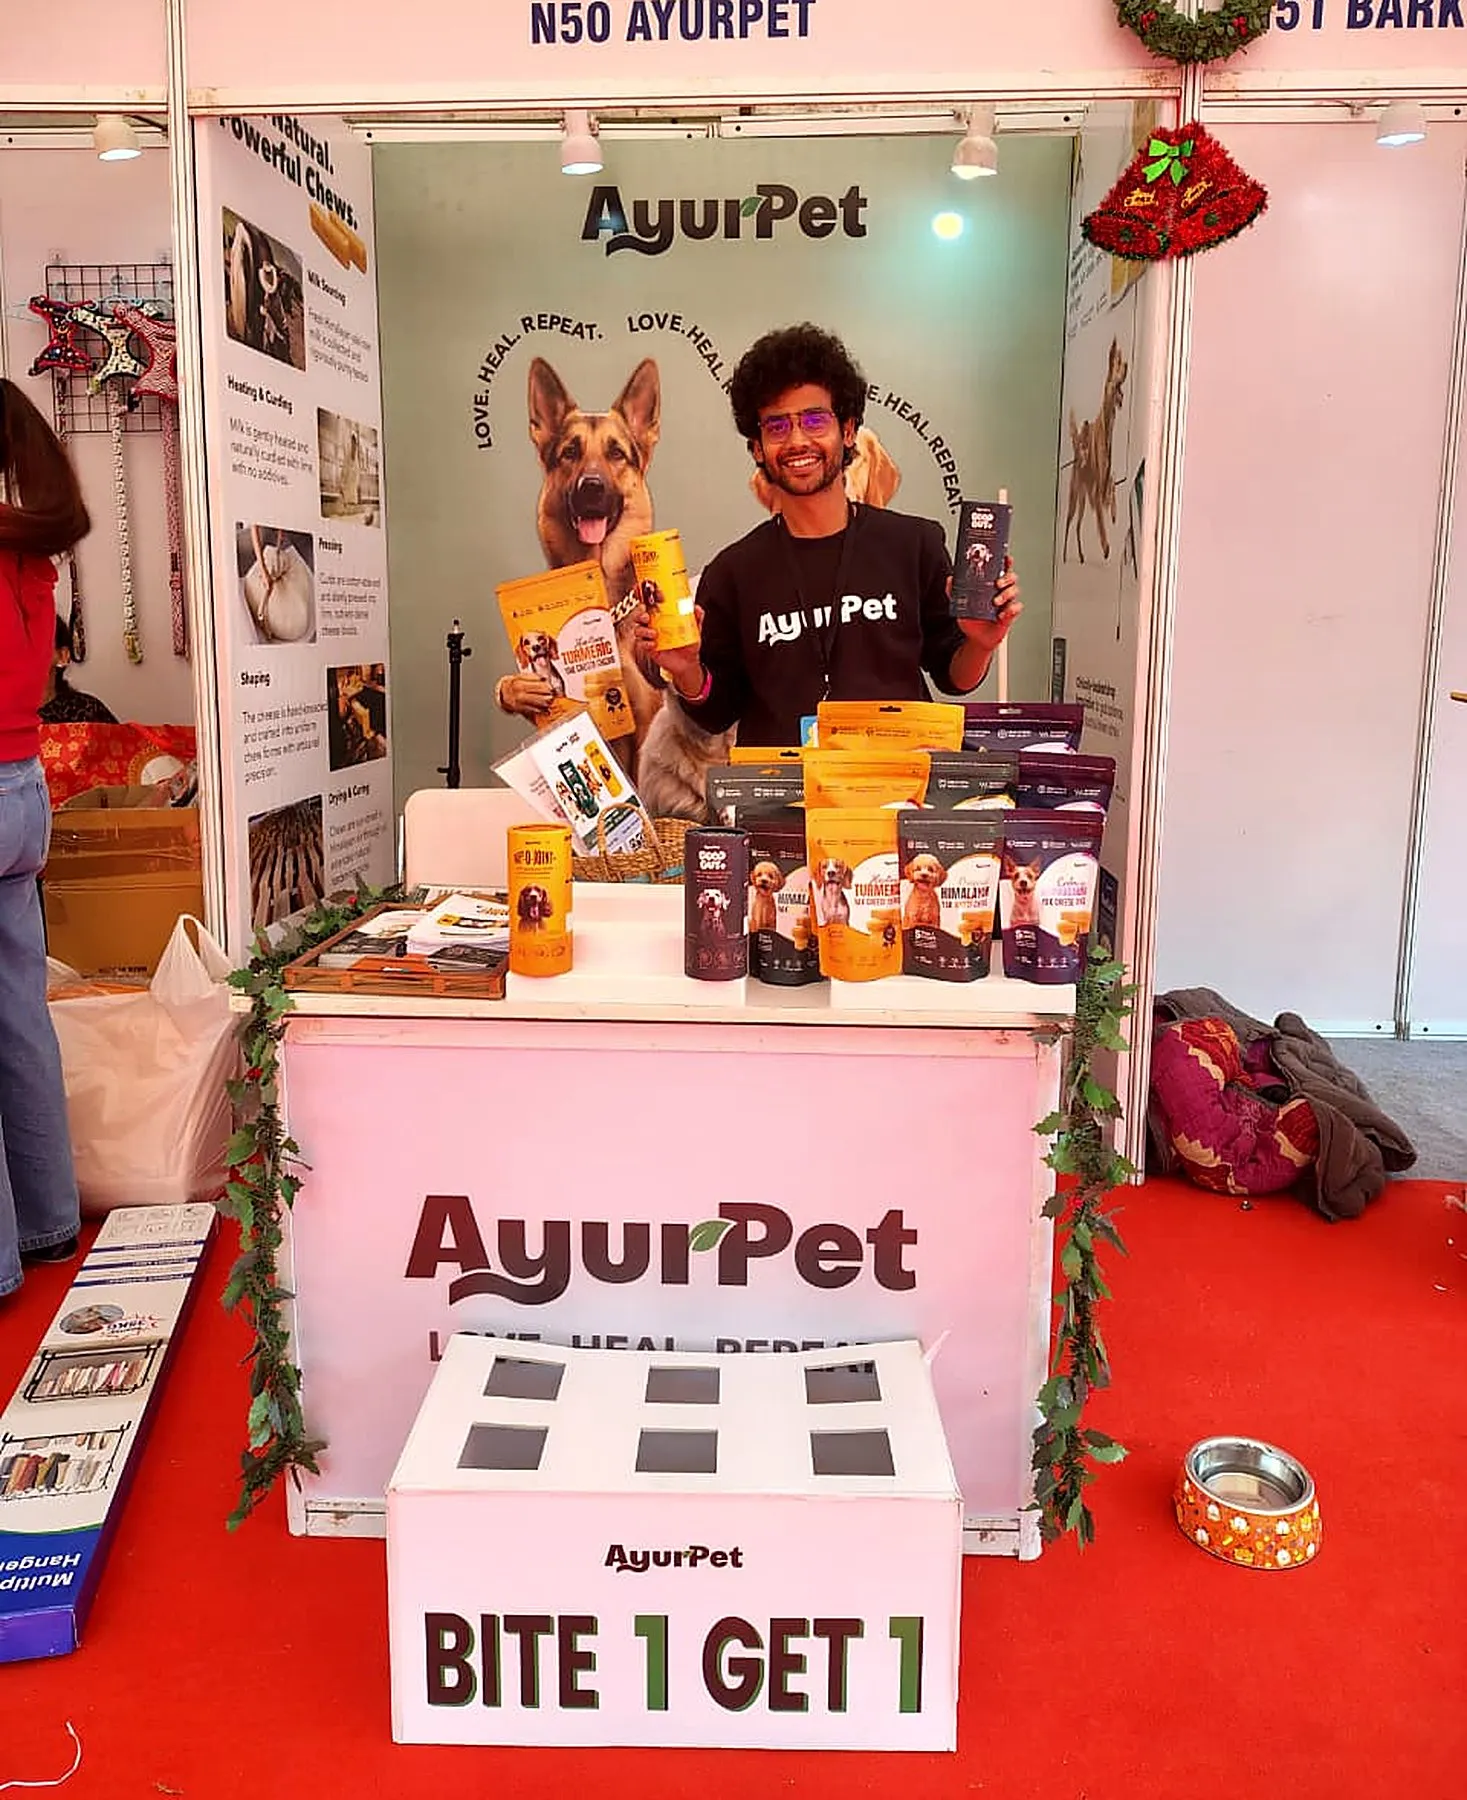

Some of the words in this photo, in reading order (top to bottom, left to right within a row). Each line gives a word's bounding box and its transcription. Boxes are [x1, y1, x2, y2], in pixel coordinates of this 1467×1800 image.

[531, 2, 611, 44] N50
[626, 0, 816, 42] AYURPET
[1272, 0, 1323, 31] 51
[1346, 0, 1465, 29] BARK
[305, 166, 358, 230] Chews.
[581, 184, 868, 257] AyurPet
[520, 313, 603, 341] REPEAT.
[627, 313, 686, 335] LOVE.
[685, 325, 721, 383] HEAL.
[477, 331, 522, 384] HEAL.
[473, 389, 493, 449] LOVE.
[884, 391, 930, 441] HEAL.
[241, 672, 270, 688] Shaping
[403, 1194, 918, 1306] AyurPet
[604, 1544, 744, 1573] AyurPet
[424, 1612, 599, 1710] BITE
[634, 1614, 669, 1711] 1
[702, 1615, 865, 1713] GET
[888, 1615, 924, 1714] 1
